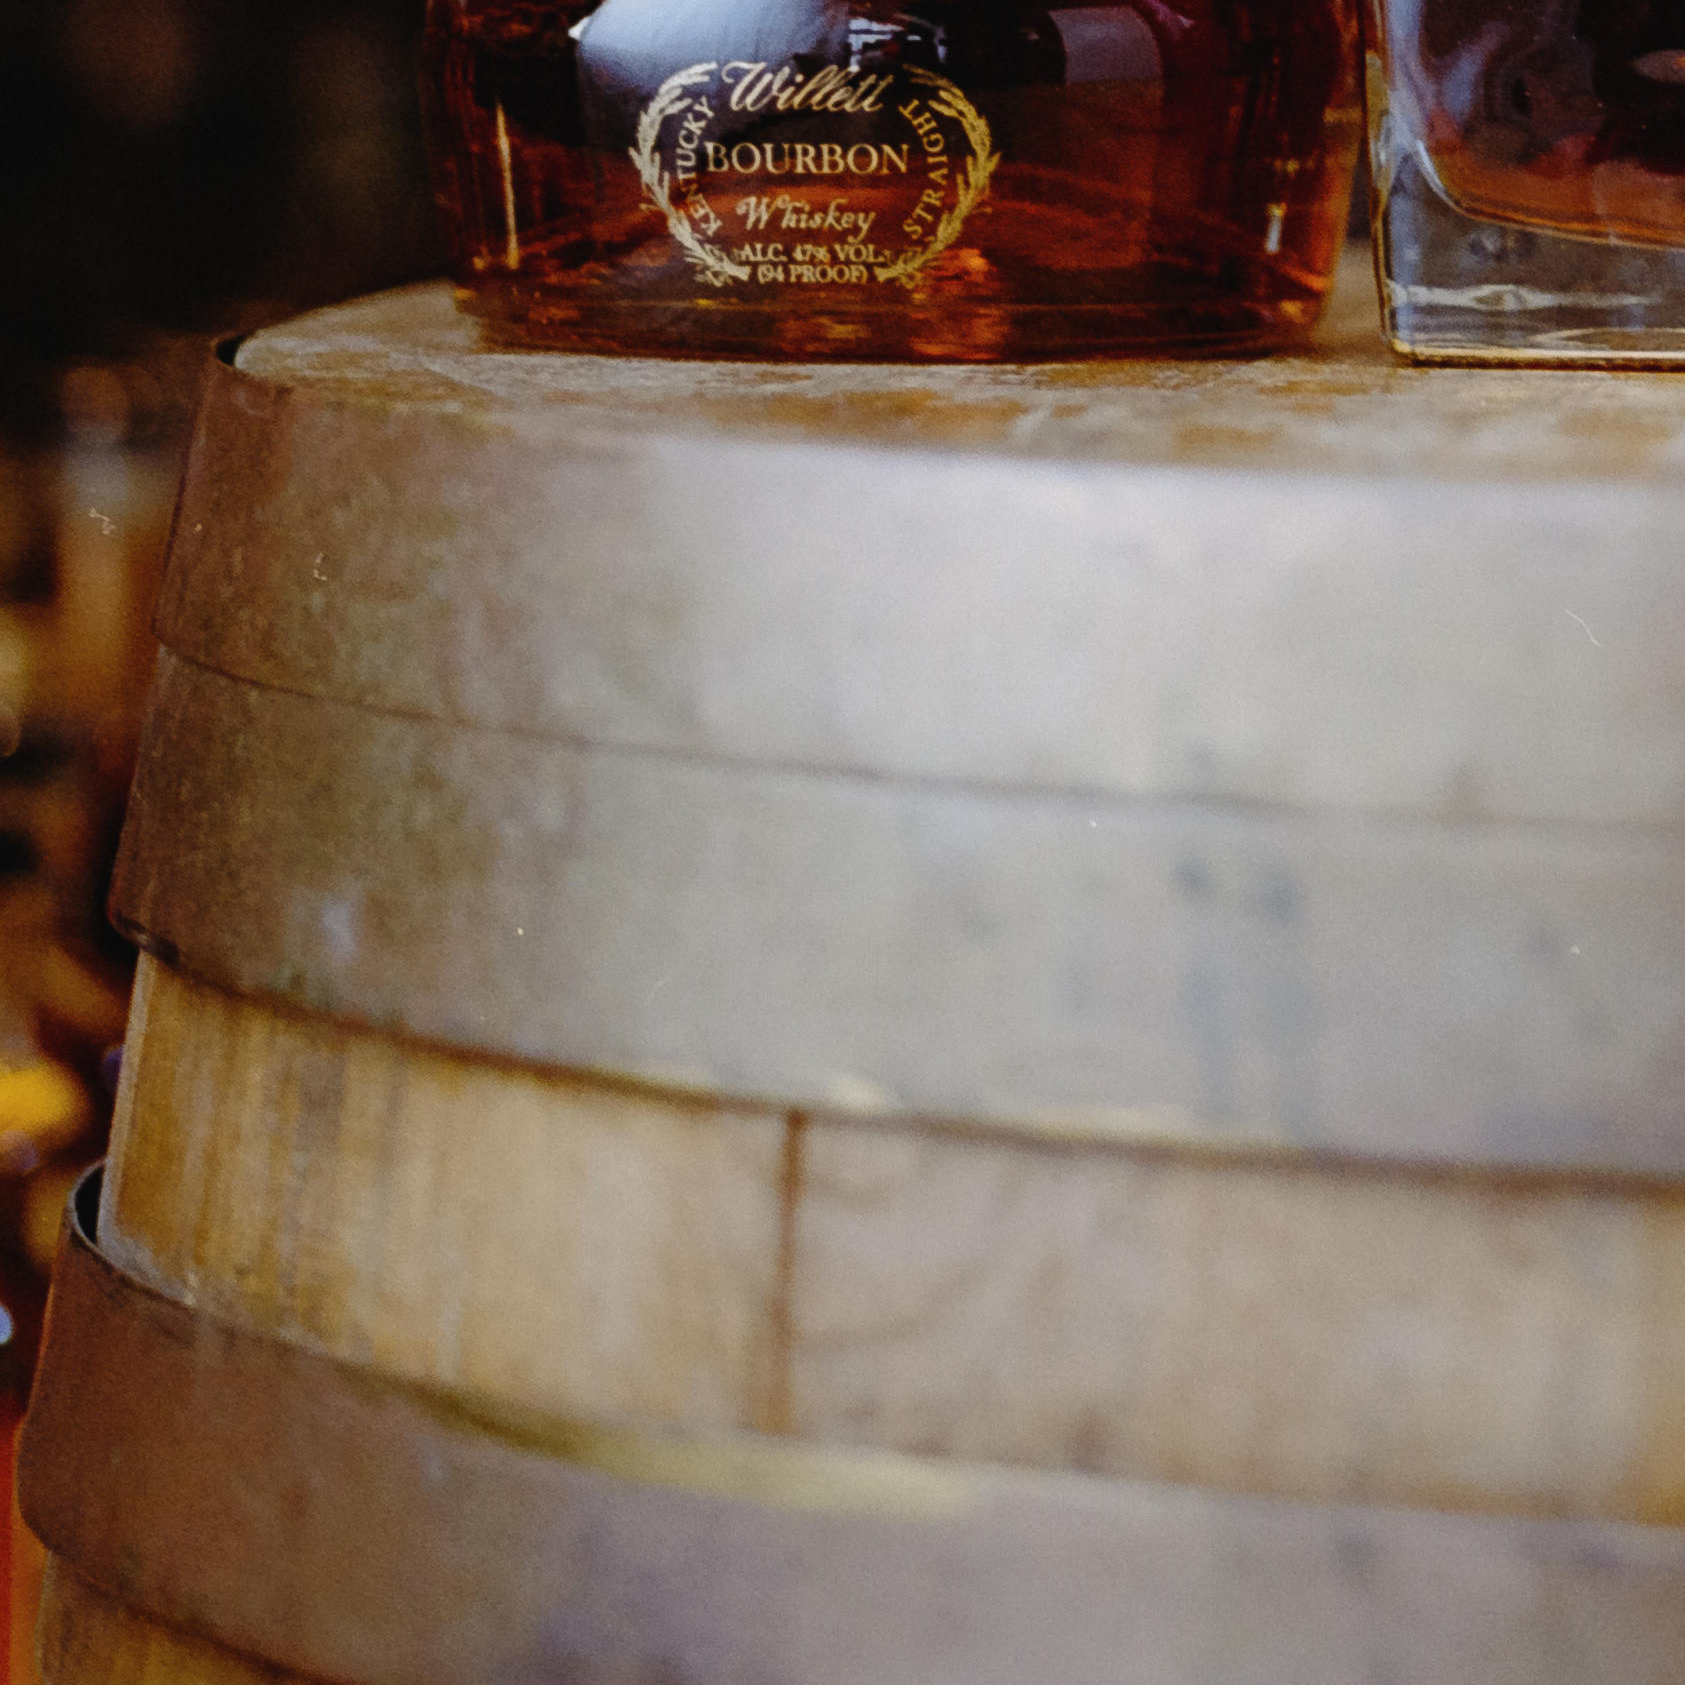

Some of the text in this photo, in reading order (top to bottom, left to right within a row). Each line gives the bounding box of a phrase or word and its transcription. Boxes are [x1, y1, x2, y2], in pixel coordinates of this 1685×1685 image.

[721, 60, 894, 114] Willett
[676, 95, 722, 237] KENTUCKY
[703, 142, 911, 176] BOURBON
[898, 99, 949, 239] STRAIGHT
[736, 194, 876, 245] Whiskey
[756, 264, 869, 285] (94 PROOF)
